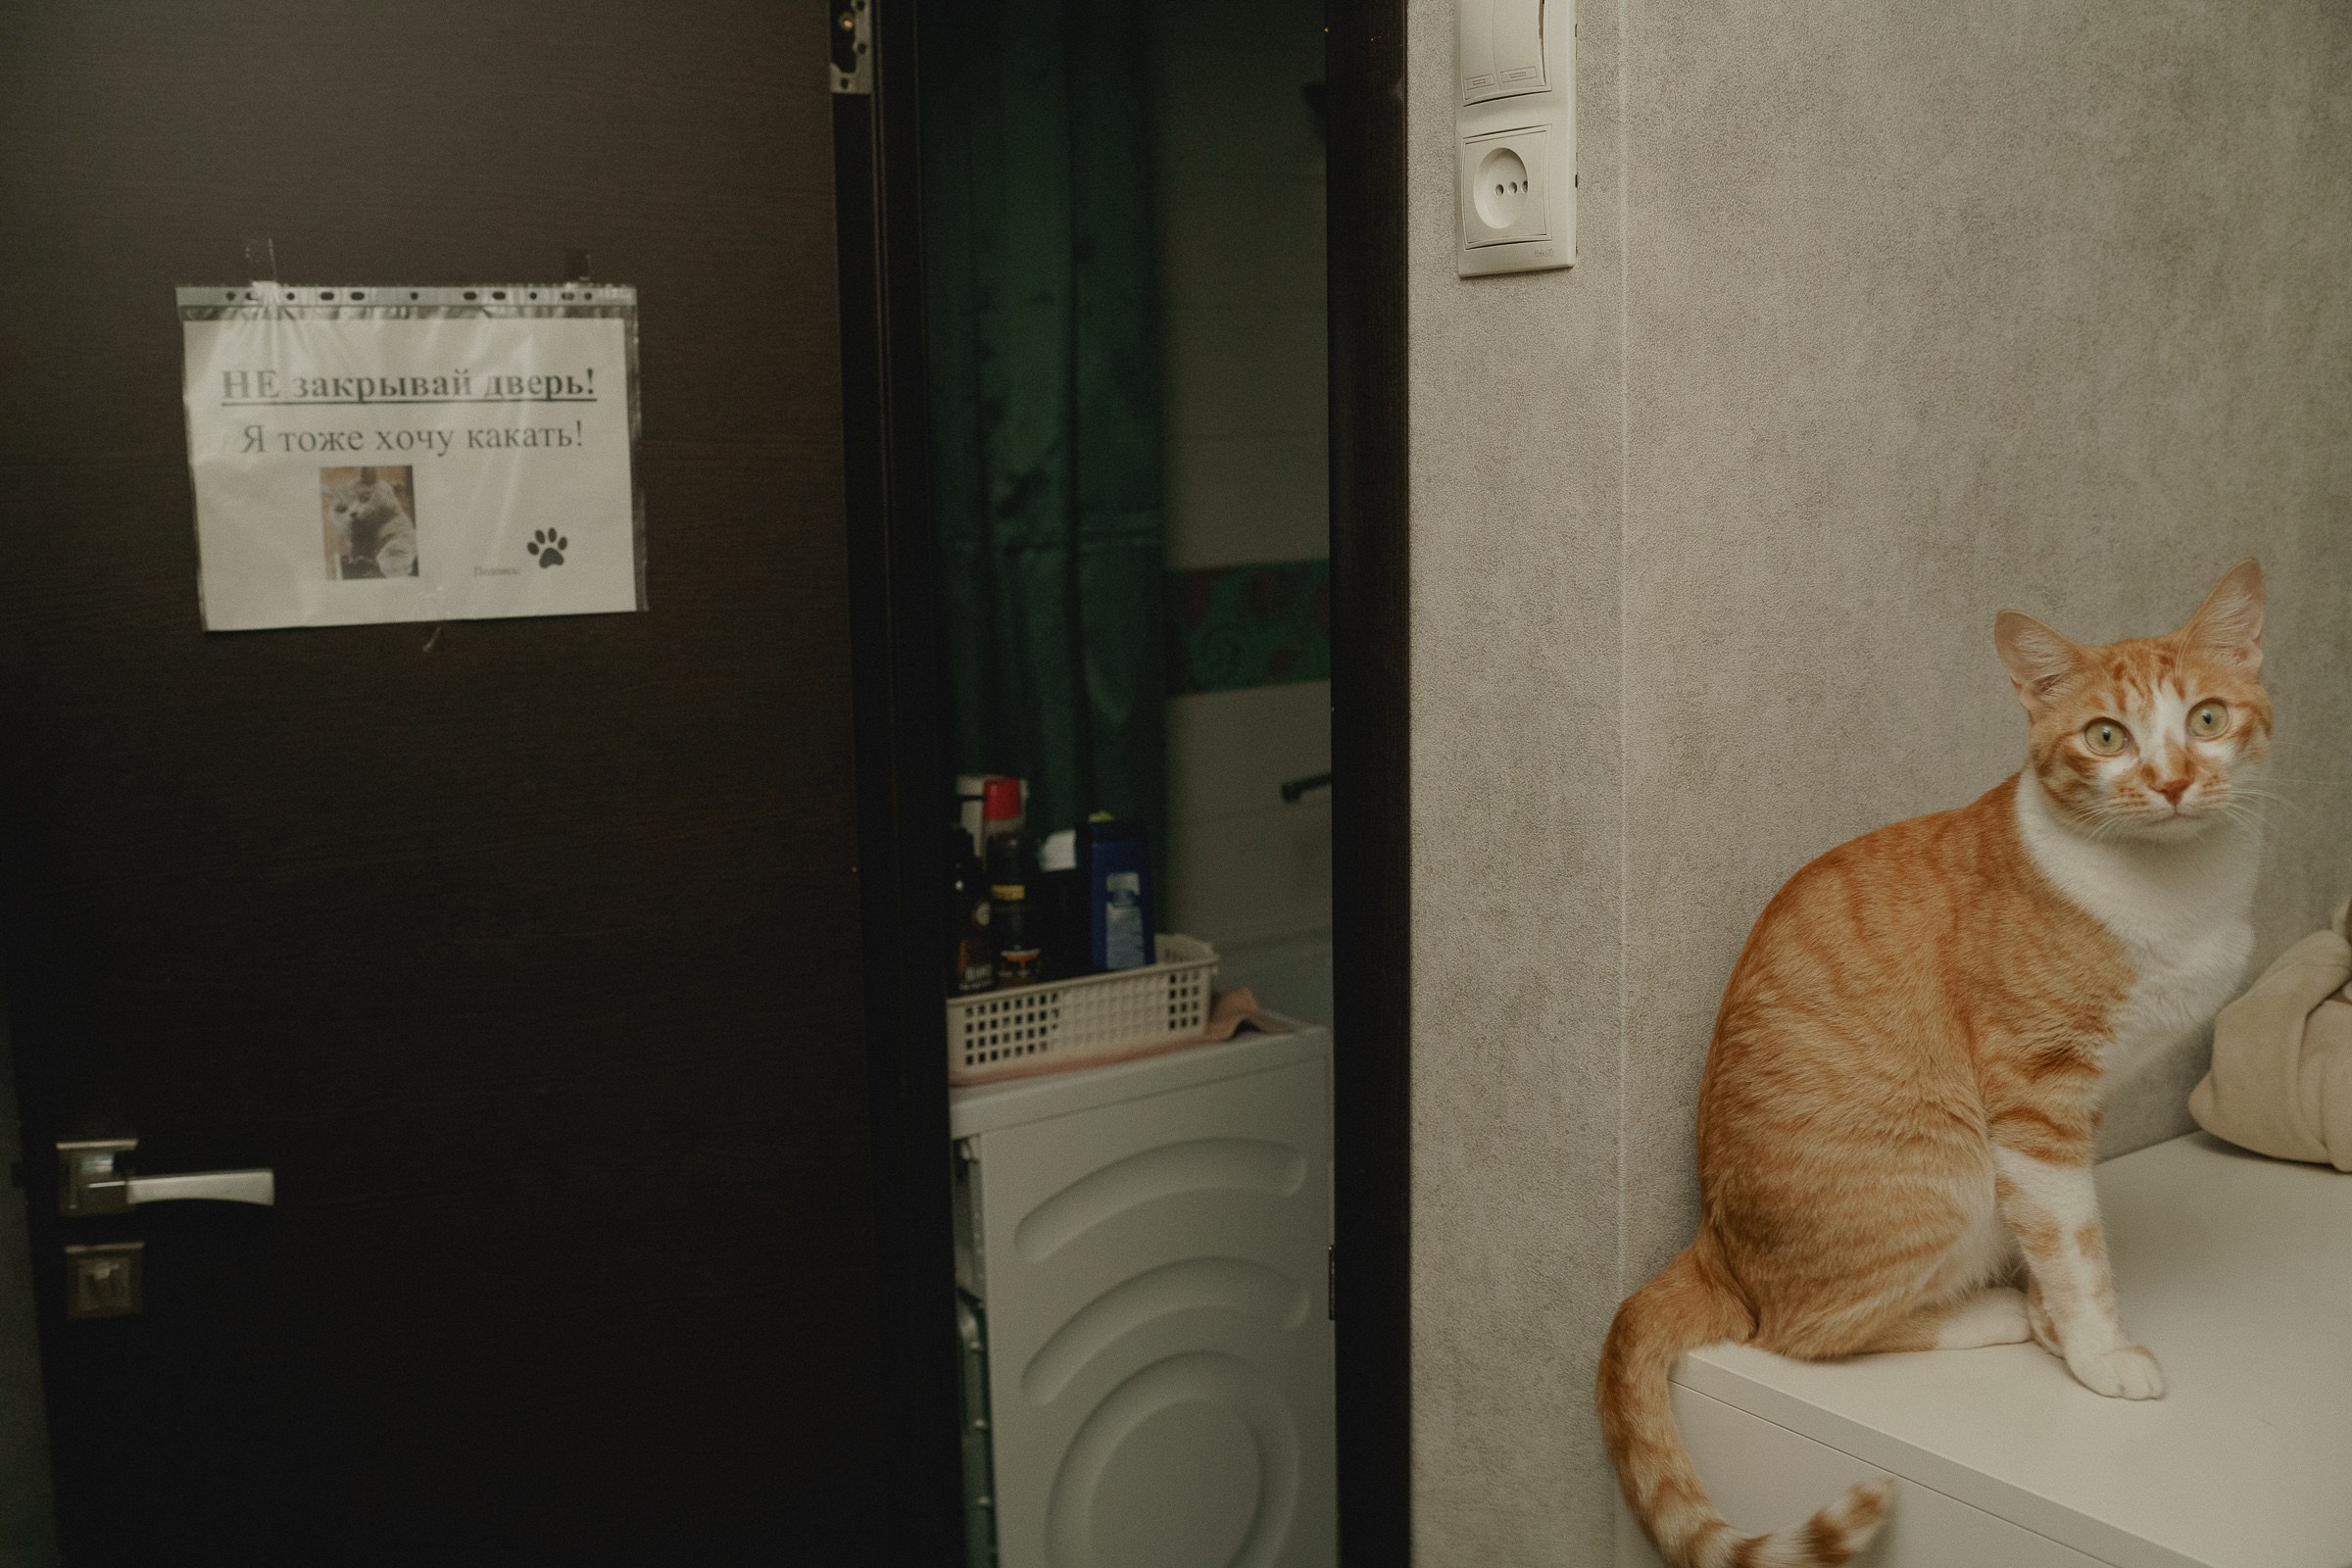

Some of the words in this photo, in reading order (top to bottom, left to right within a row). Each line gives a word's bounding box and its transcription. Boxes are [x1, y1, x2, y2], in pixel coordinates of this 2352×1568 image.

[222, 369, 281, 401] НЕ
[294, 368, 472, 403] закрывай
[484, 367, 597, 403] дверь!
[242, 424, 267, 454] Я
[277, 428, 365, 452] тоже
[376, 428, 454, 457] хочу
[467, 420, 584, 450] какать!
